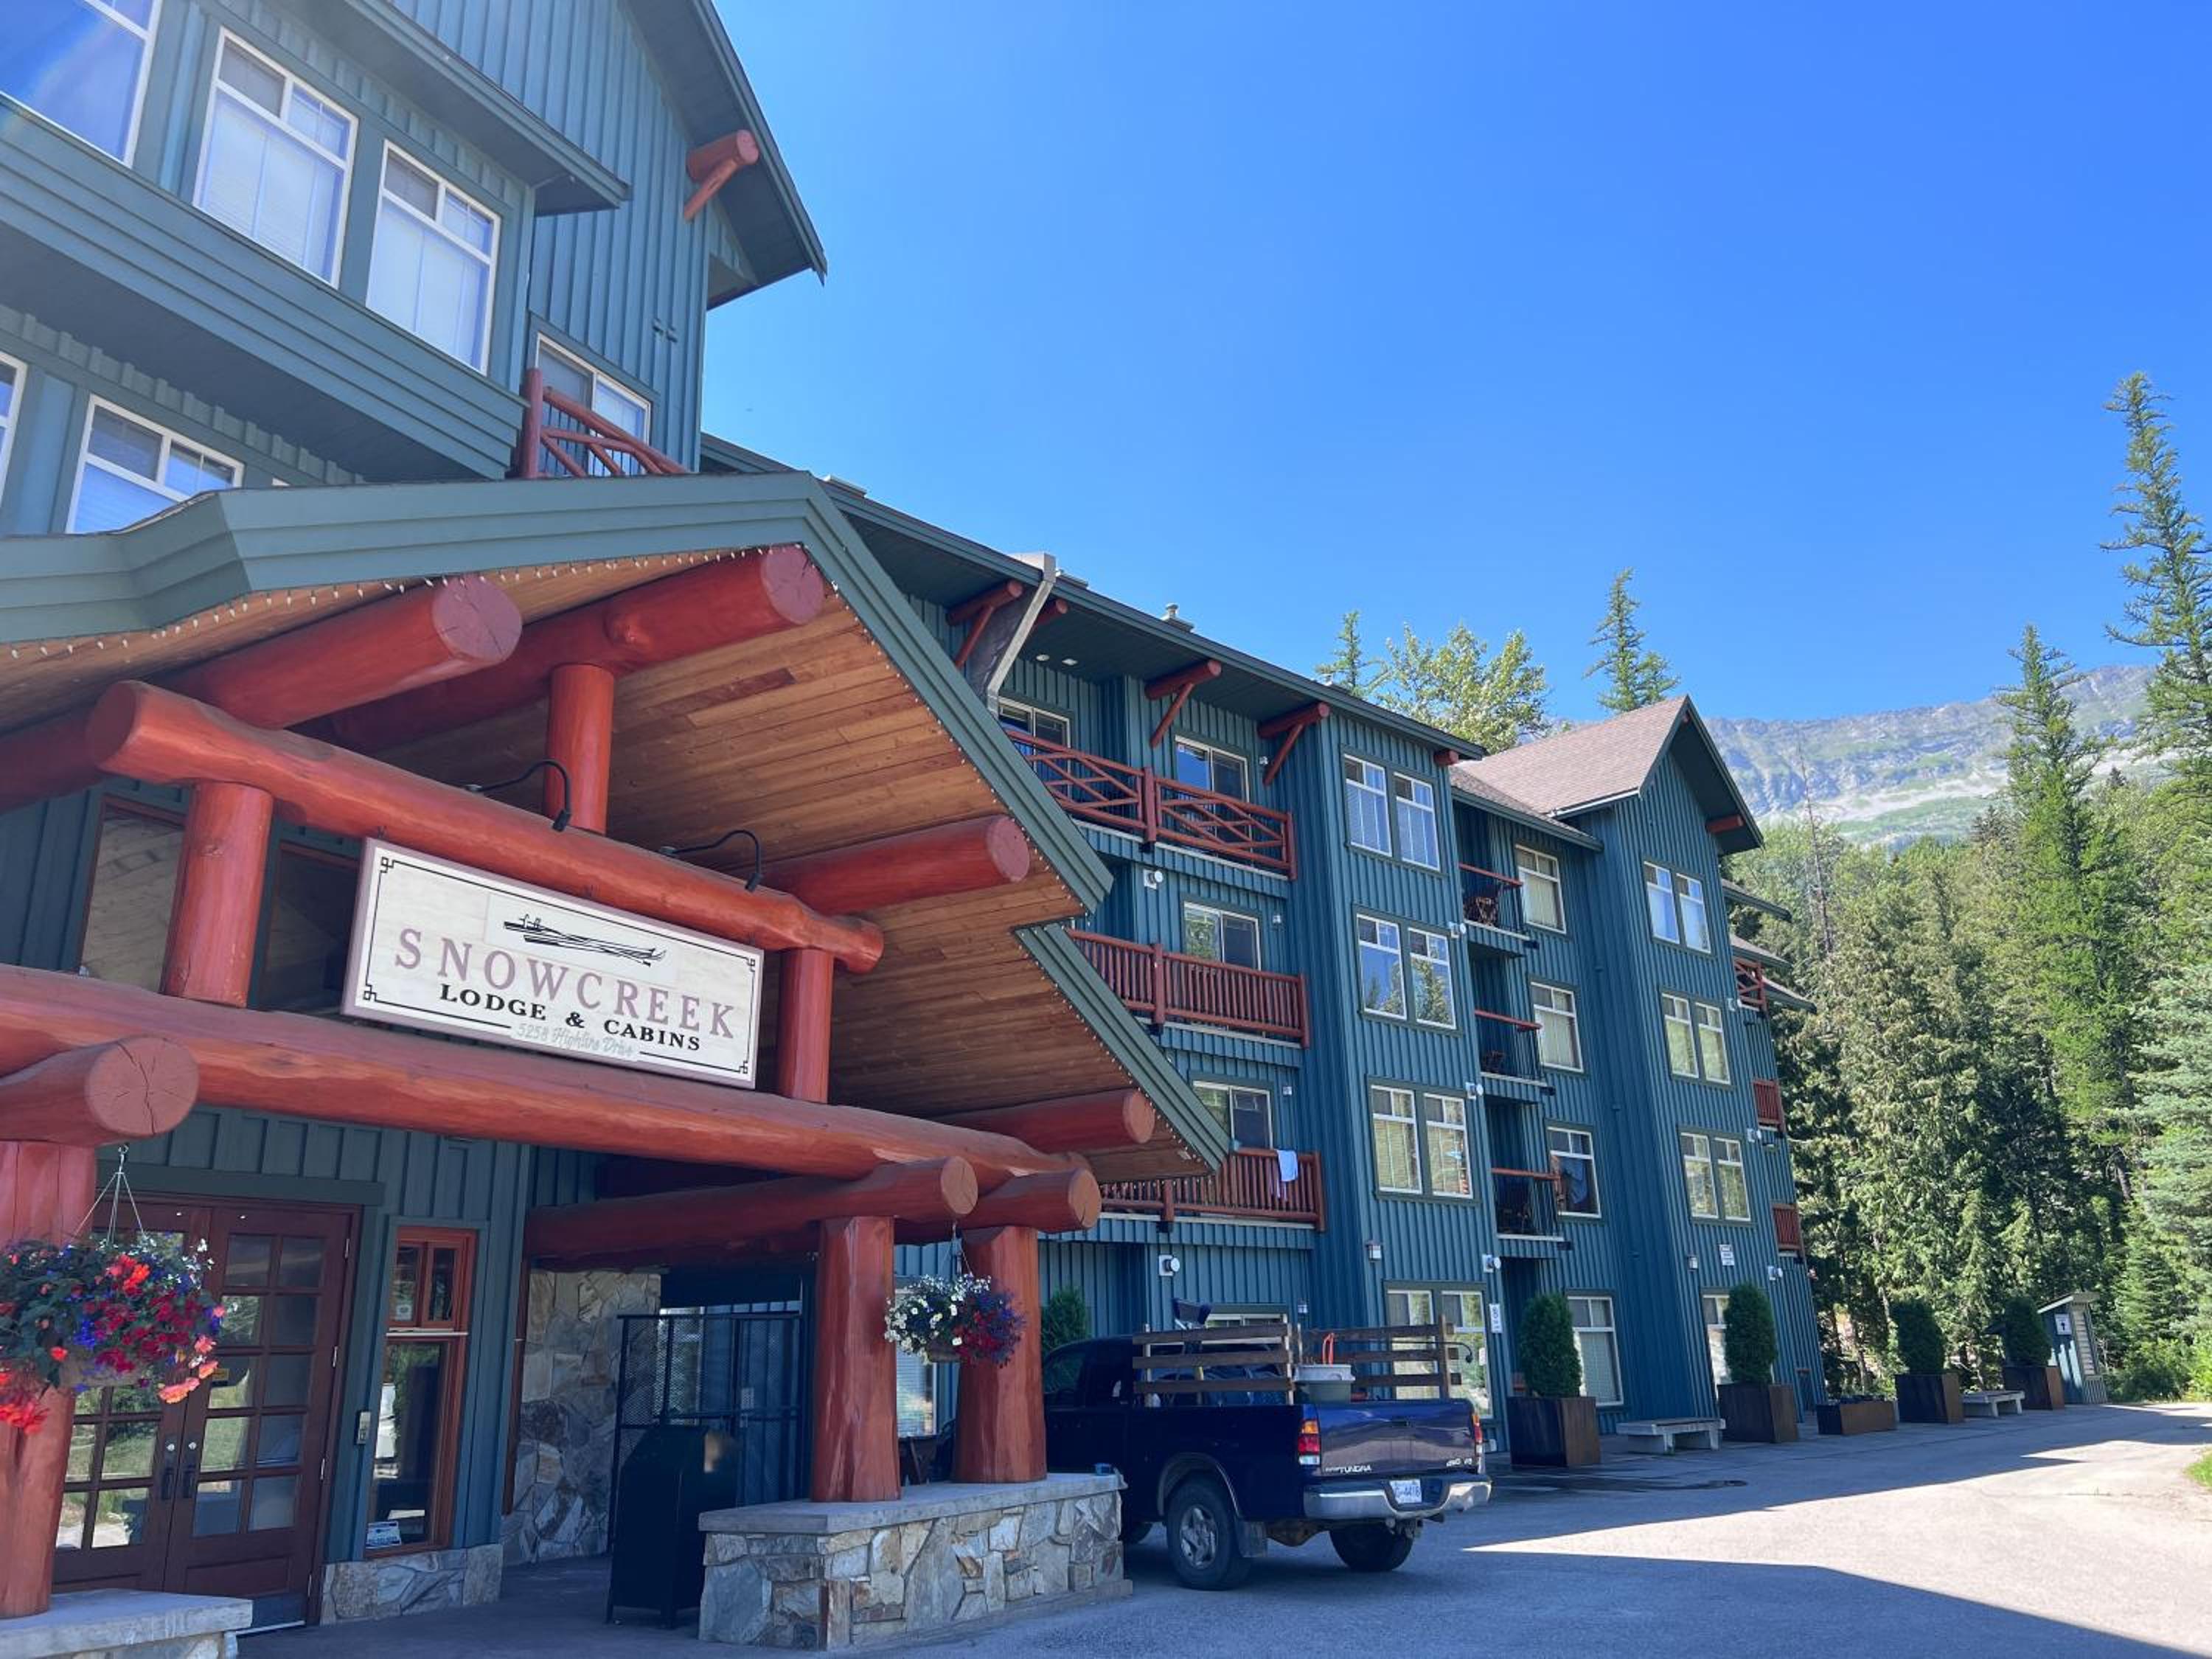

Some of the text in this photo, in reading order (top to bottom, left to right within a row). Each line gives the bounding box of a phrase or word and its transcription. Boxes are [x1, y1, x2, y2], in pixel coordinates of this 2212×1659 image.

[395, 928, 734, 1039] SNOWCREEK
[440, 984, 700, 1051] LODGE & CABINS
